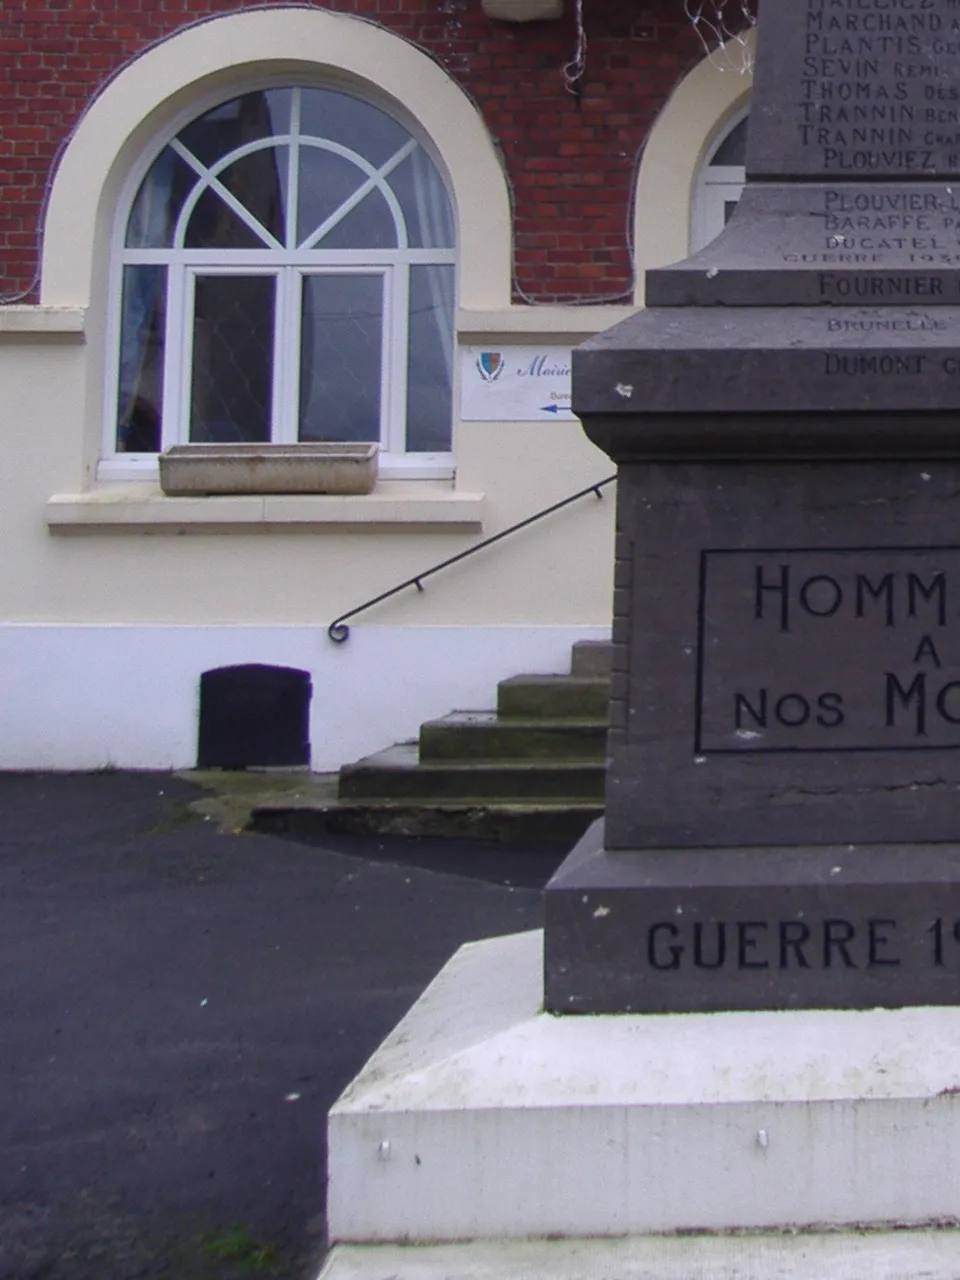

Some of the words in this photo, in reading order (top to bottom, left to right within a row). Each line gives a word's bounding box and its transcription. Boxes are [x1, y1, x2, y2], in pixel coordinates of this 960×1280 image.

[806, 10, 942, 31] MARCHAND
[805, 33, 921, 55] PLANTIS
[803, 56, 879, 77] SEVIN
[800, 80, 909, 101] THOMAS
[799, 102, 915, 123] TRANNIN
[798, 124, 913, 146] TRANNIN
[823, 148, 936, 170] PLOUVIEZ
[824, 190, 938, 211] PLOUVIER
[824, 213, 931, 231] BARAFFE
[825, 237, 946, 250] DUCATEL
[783, 253, 887, 263] GUERRE
[819, 273, 943, 296] FOURNIER
[827, 318, 947, 332] BRUNELLE
[825, 352, 925, 375] DUMONT
[912, 634, 942, 669] A
[733, 687, 846, 729] NOS
[646, 917, 903, 974] GUERRE
